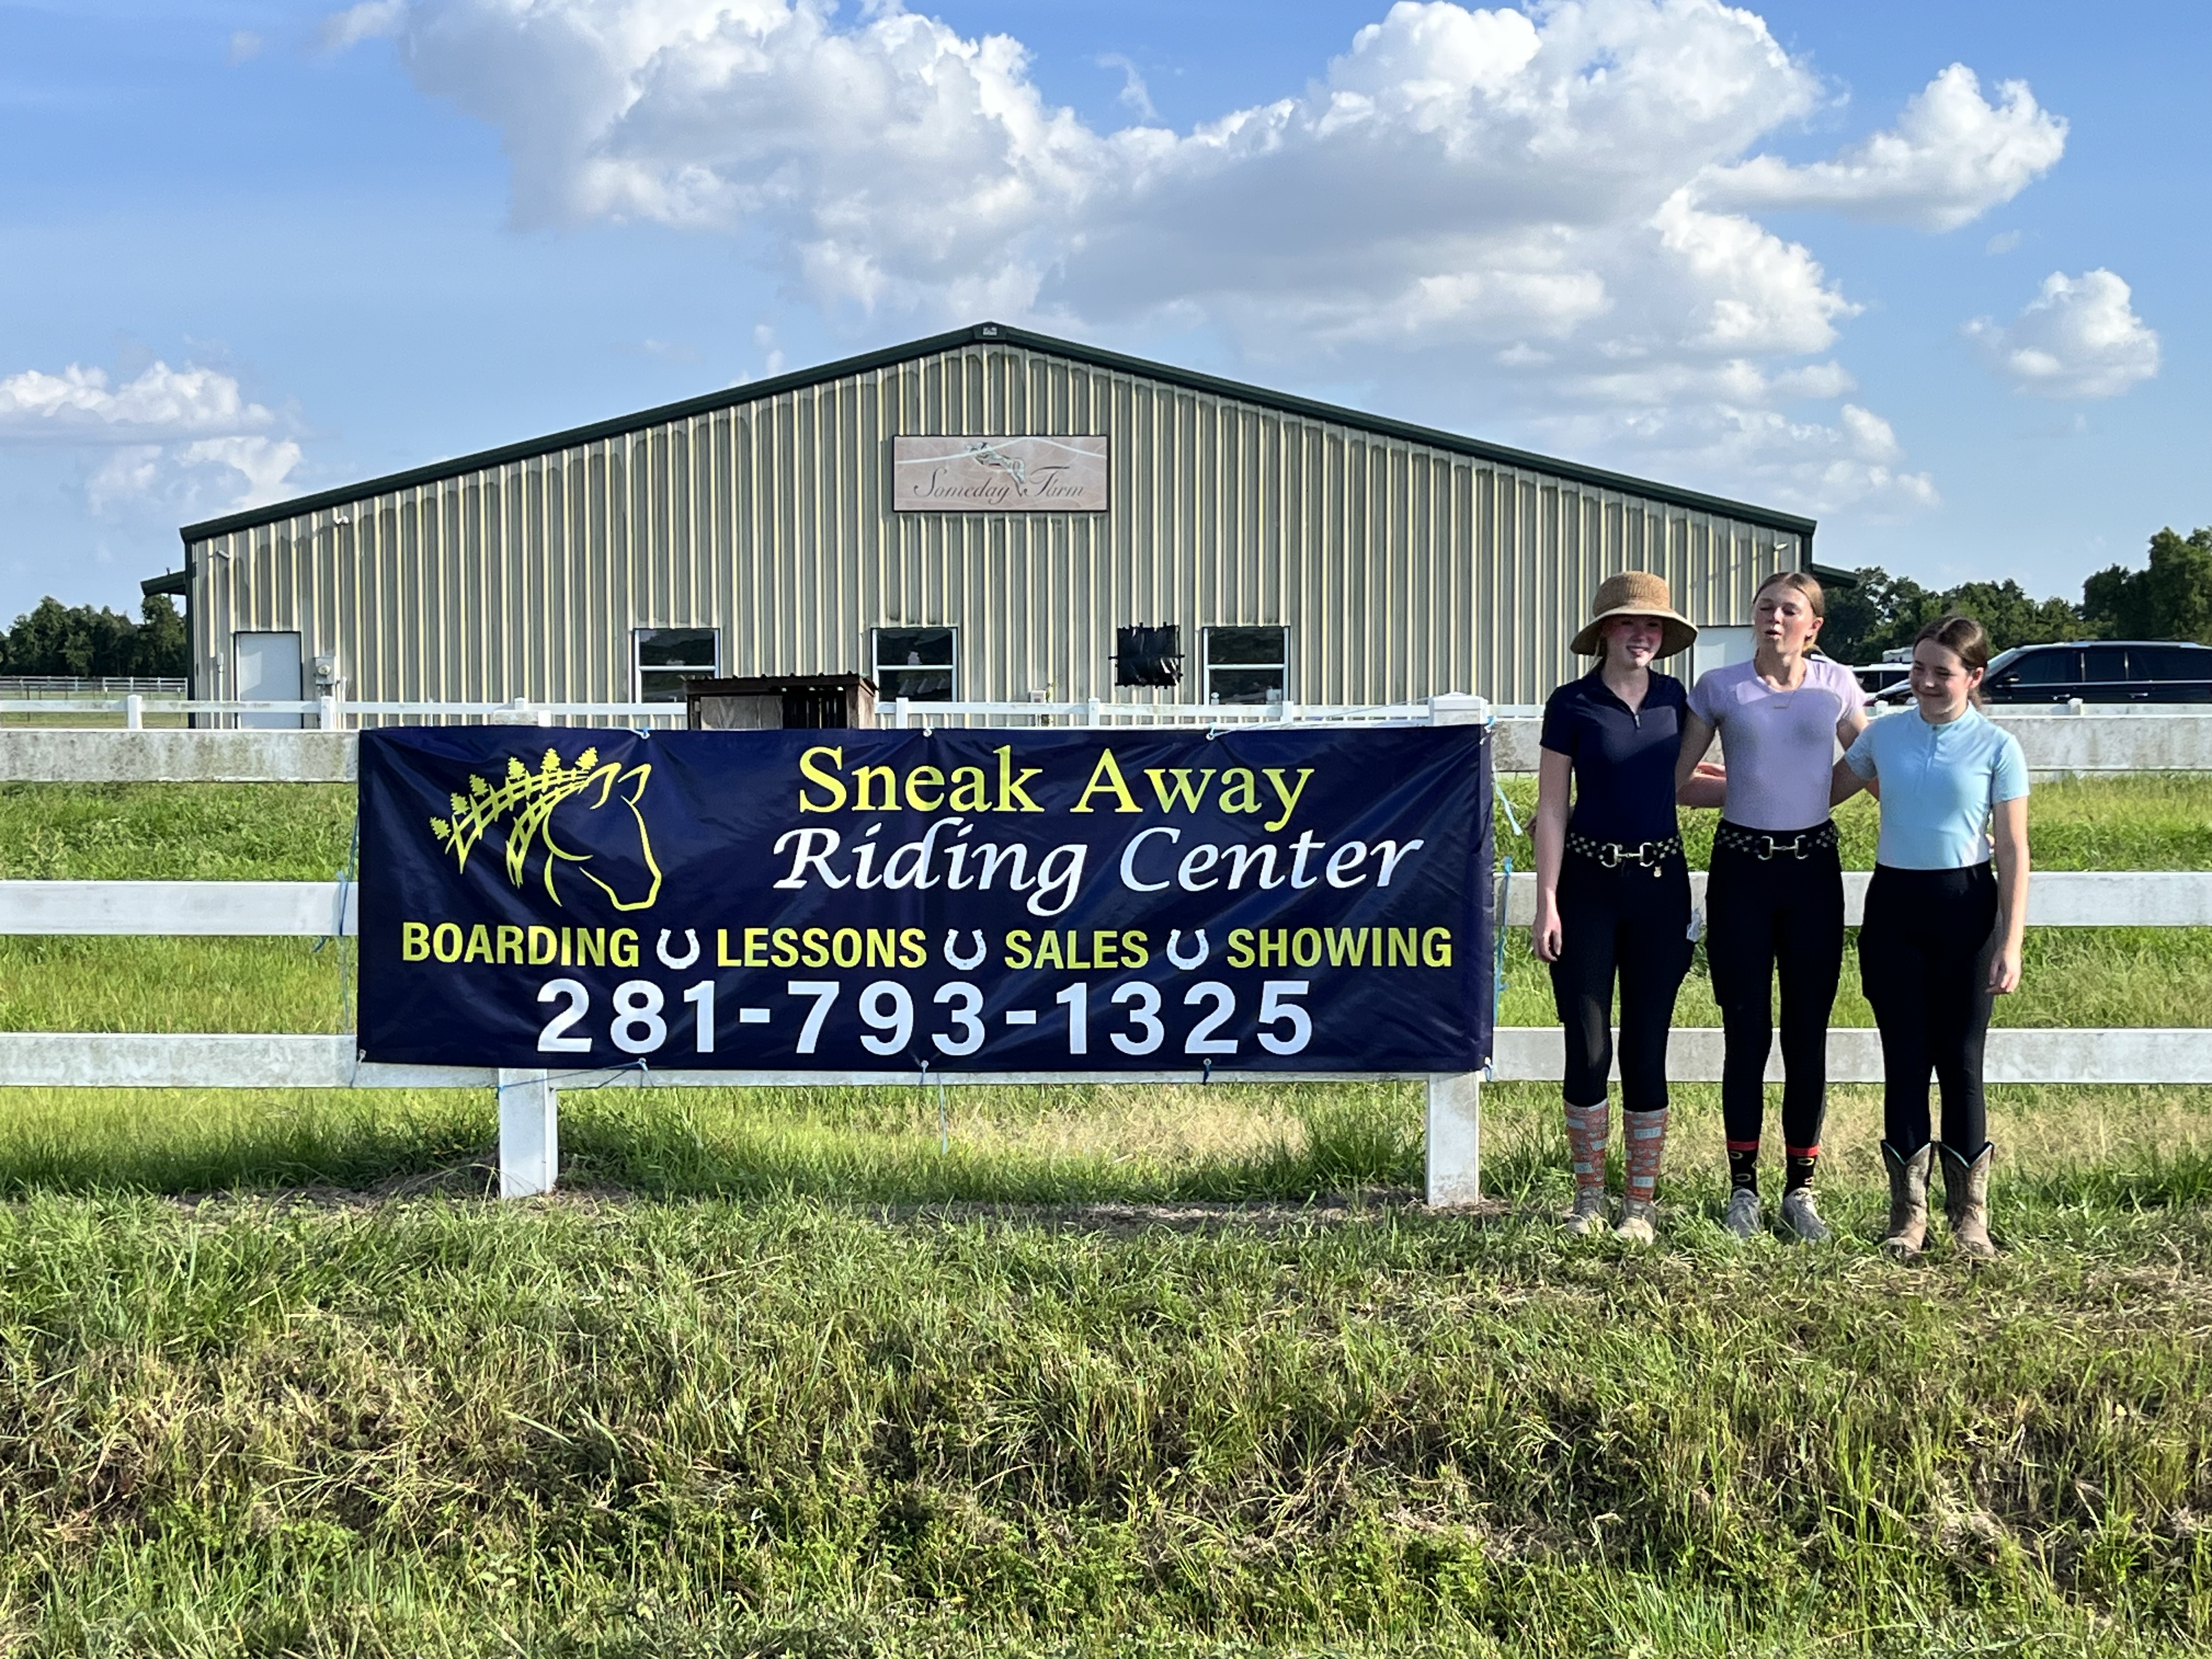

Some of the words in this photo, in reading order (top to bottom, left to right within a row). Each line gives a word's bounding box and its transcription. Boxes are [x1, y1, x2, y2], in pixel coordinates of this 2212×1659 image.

[913, 466, 1011, 505] Someday
[798, 744, 1045, 813] Sneak
[1069, 748, 1315, 832] Away
[772, 816, 1088, 917] Riding
[1119, 826, 1425, 891] Center
[402, 922, 639, 968] BOARDING
[717, 927, 927, 969] LESSONS
[1004, 929, 1149, 970] SALES
[1226, 927, 1452, 969] SHOWING
[537, 978, 1313, 1056] 281-793-1325
